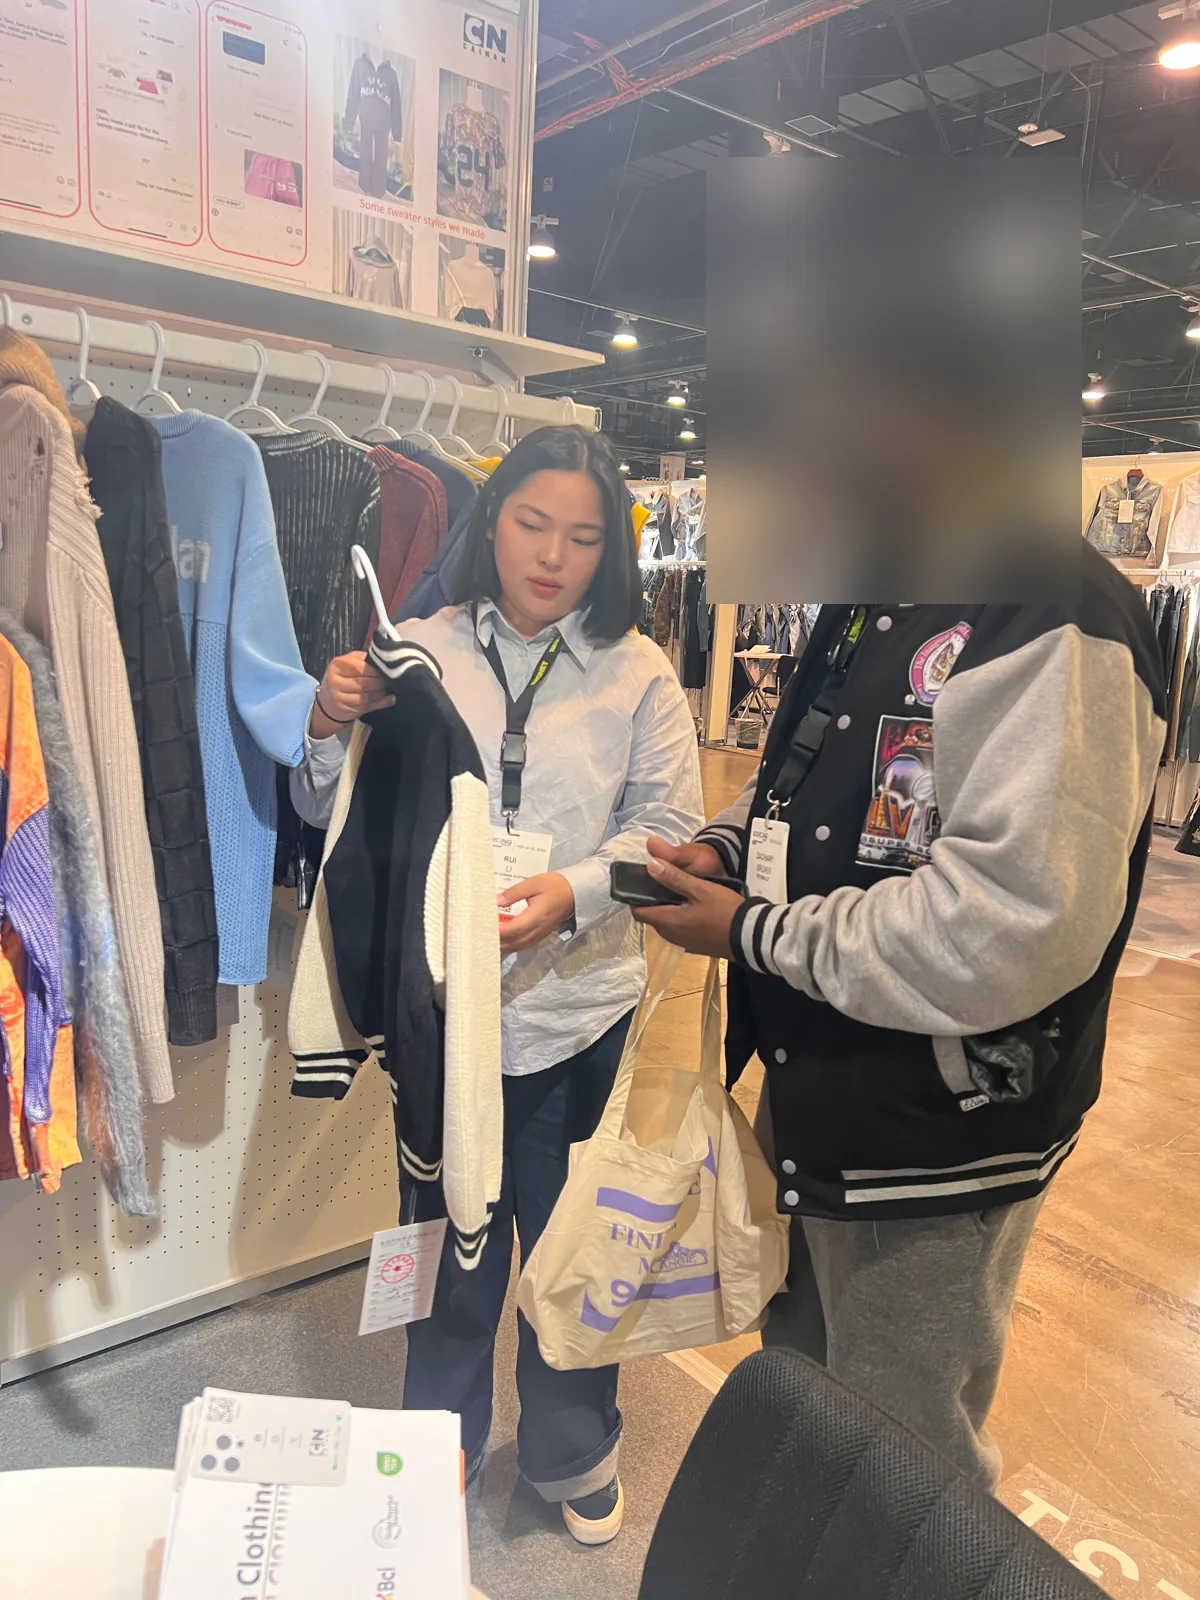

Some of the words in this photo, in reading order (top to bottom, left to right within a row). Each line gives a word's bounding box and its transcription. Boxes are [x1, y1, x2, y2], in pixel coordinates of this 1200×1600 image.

[463, 12, 508, 54] CN
[457, 145, 491, 192] 24
[359, 198, 385, 214] Some
[387, 207, 421, 223] sweater
[423, 216, 447, 230] styles
[448, 222, 461, 233] we
[462, 225, 486, 240] made
[503, 855, 517, 864] RUI
[236, 1481, 275, 1586] Clothin
